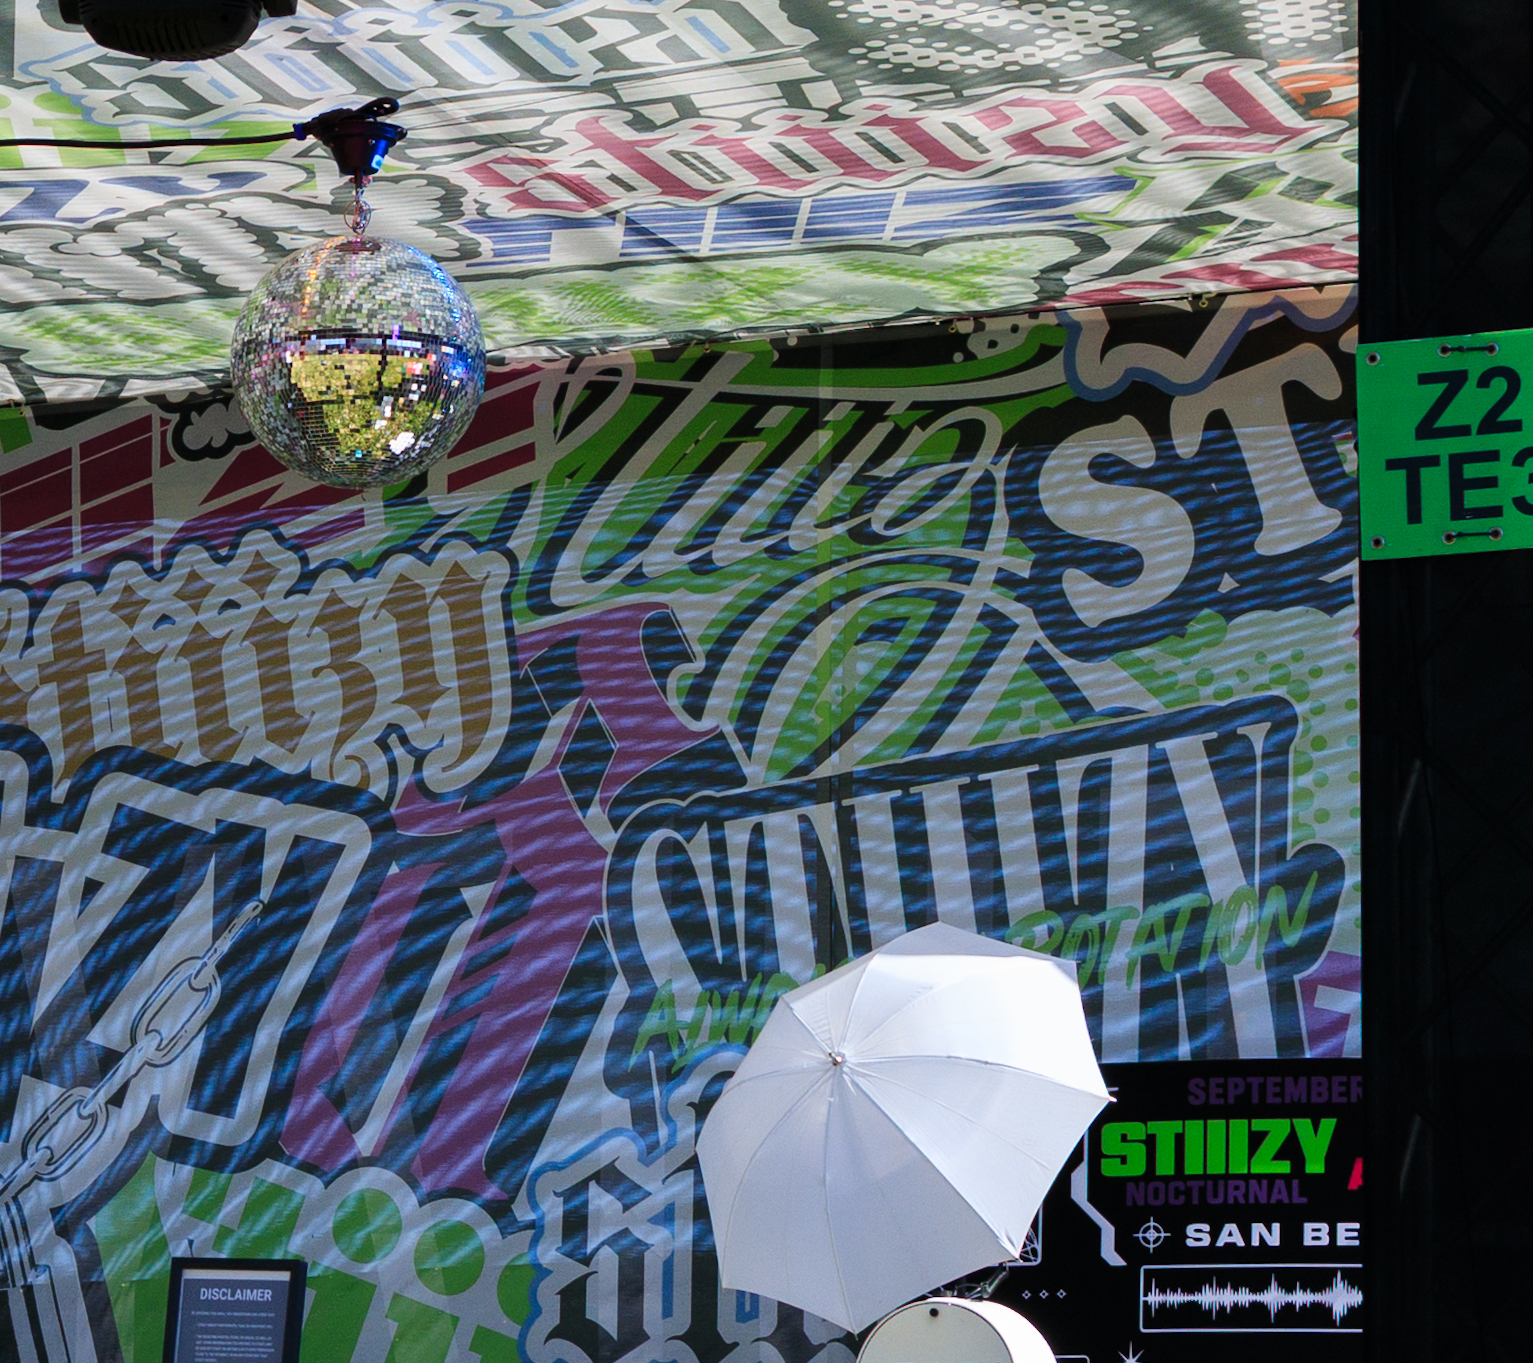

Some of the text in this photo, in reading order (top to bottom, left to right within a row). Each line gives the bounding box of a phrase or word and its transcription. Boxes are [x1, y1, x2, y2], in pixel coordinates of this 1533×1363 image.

[1414, 366, 1524, 441] Z2
[1187, 1075, 1363, 1106] SEPTEMBER
[1100, 1117, 1338, 1178] STIIIZY
[1125, 1178, 1308, 1207] NOCTURNAL
[1184, 1222, 1281, 1248] SAN
[199, 1287, 273, 1302] DISCLAIMER
